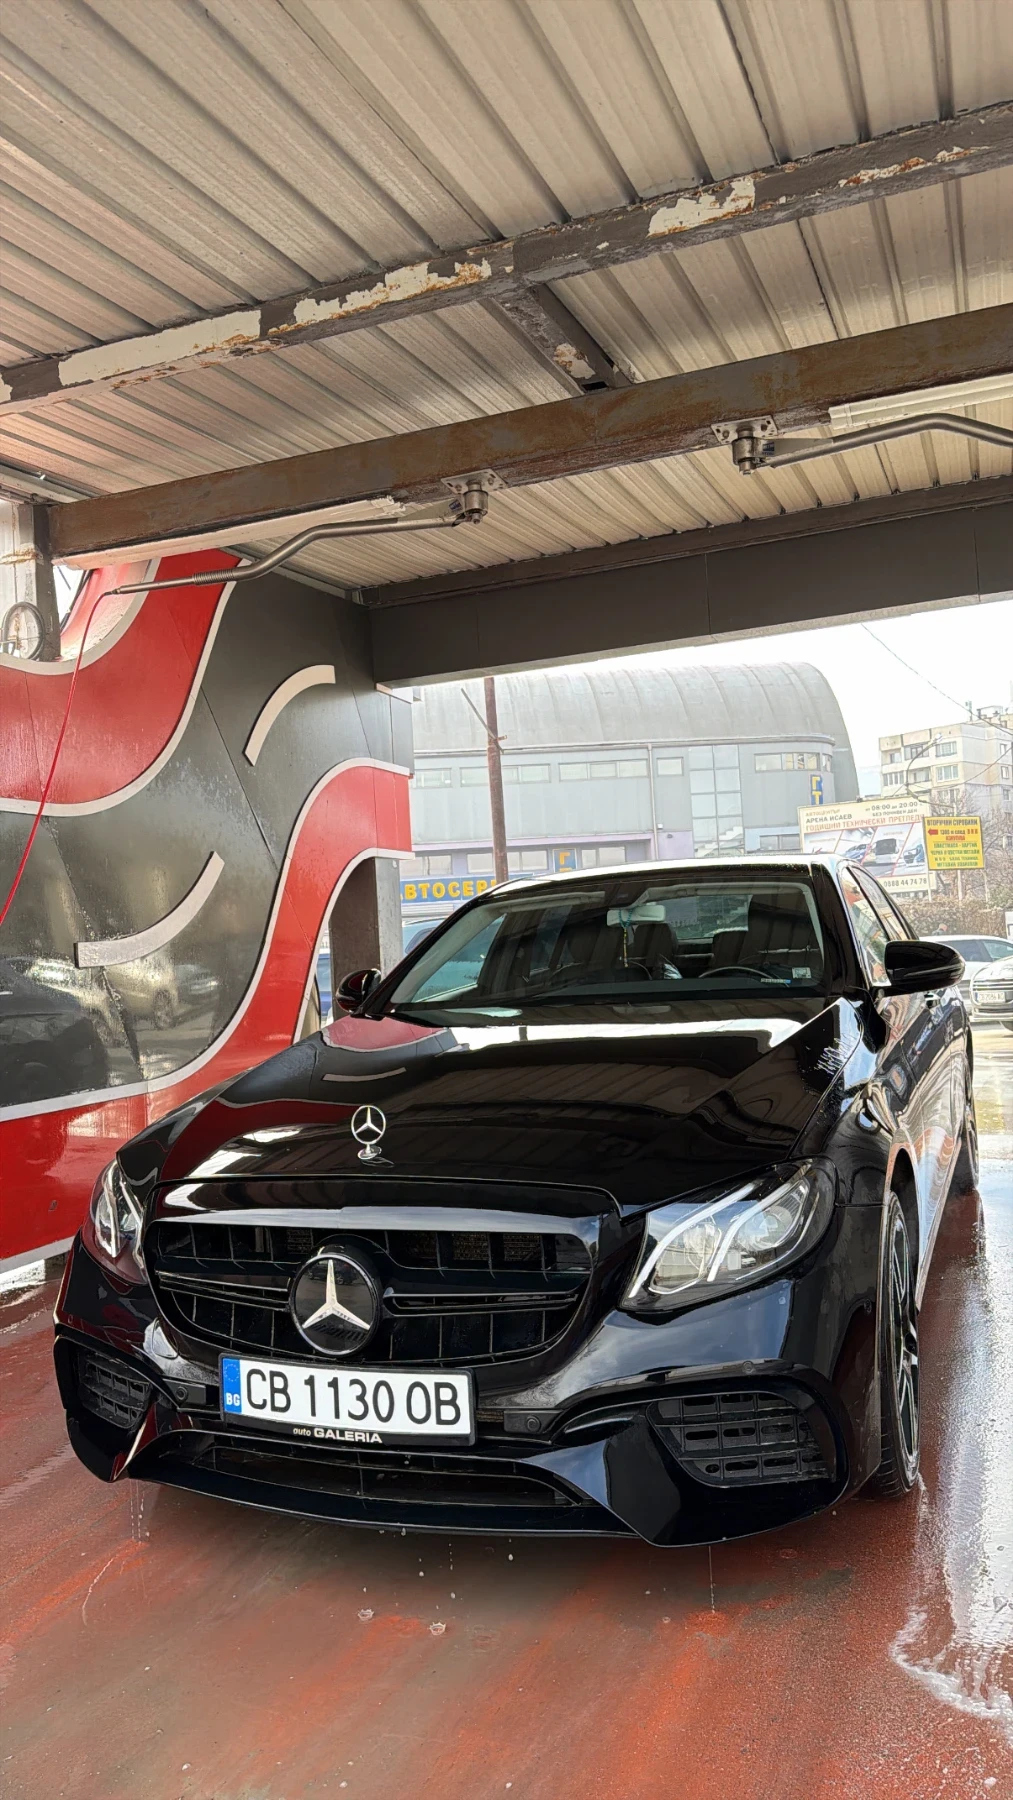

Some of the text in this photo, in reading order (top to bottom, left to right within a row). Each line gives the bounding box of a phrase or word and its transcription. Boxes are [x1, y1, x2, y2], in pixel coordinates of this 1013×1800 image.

[871, 803, 891, 811] 08:00
[898, 801, 918, 809] 20:00
[806, 813, 853, 824] АРЕНА ИСАЕВ
[400, 879, 497, 900] ВТОСЕР
[225, 1368, 462, 1426] BG CB 1130 OB
[292, 1427, 383, 1444] auto GALERIA
